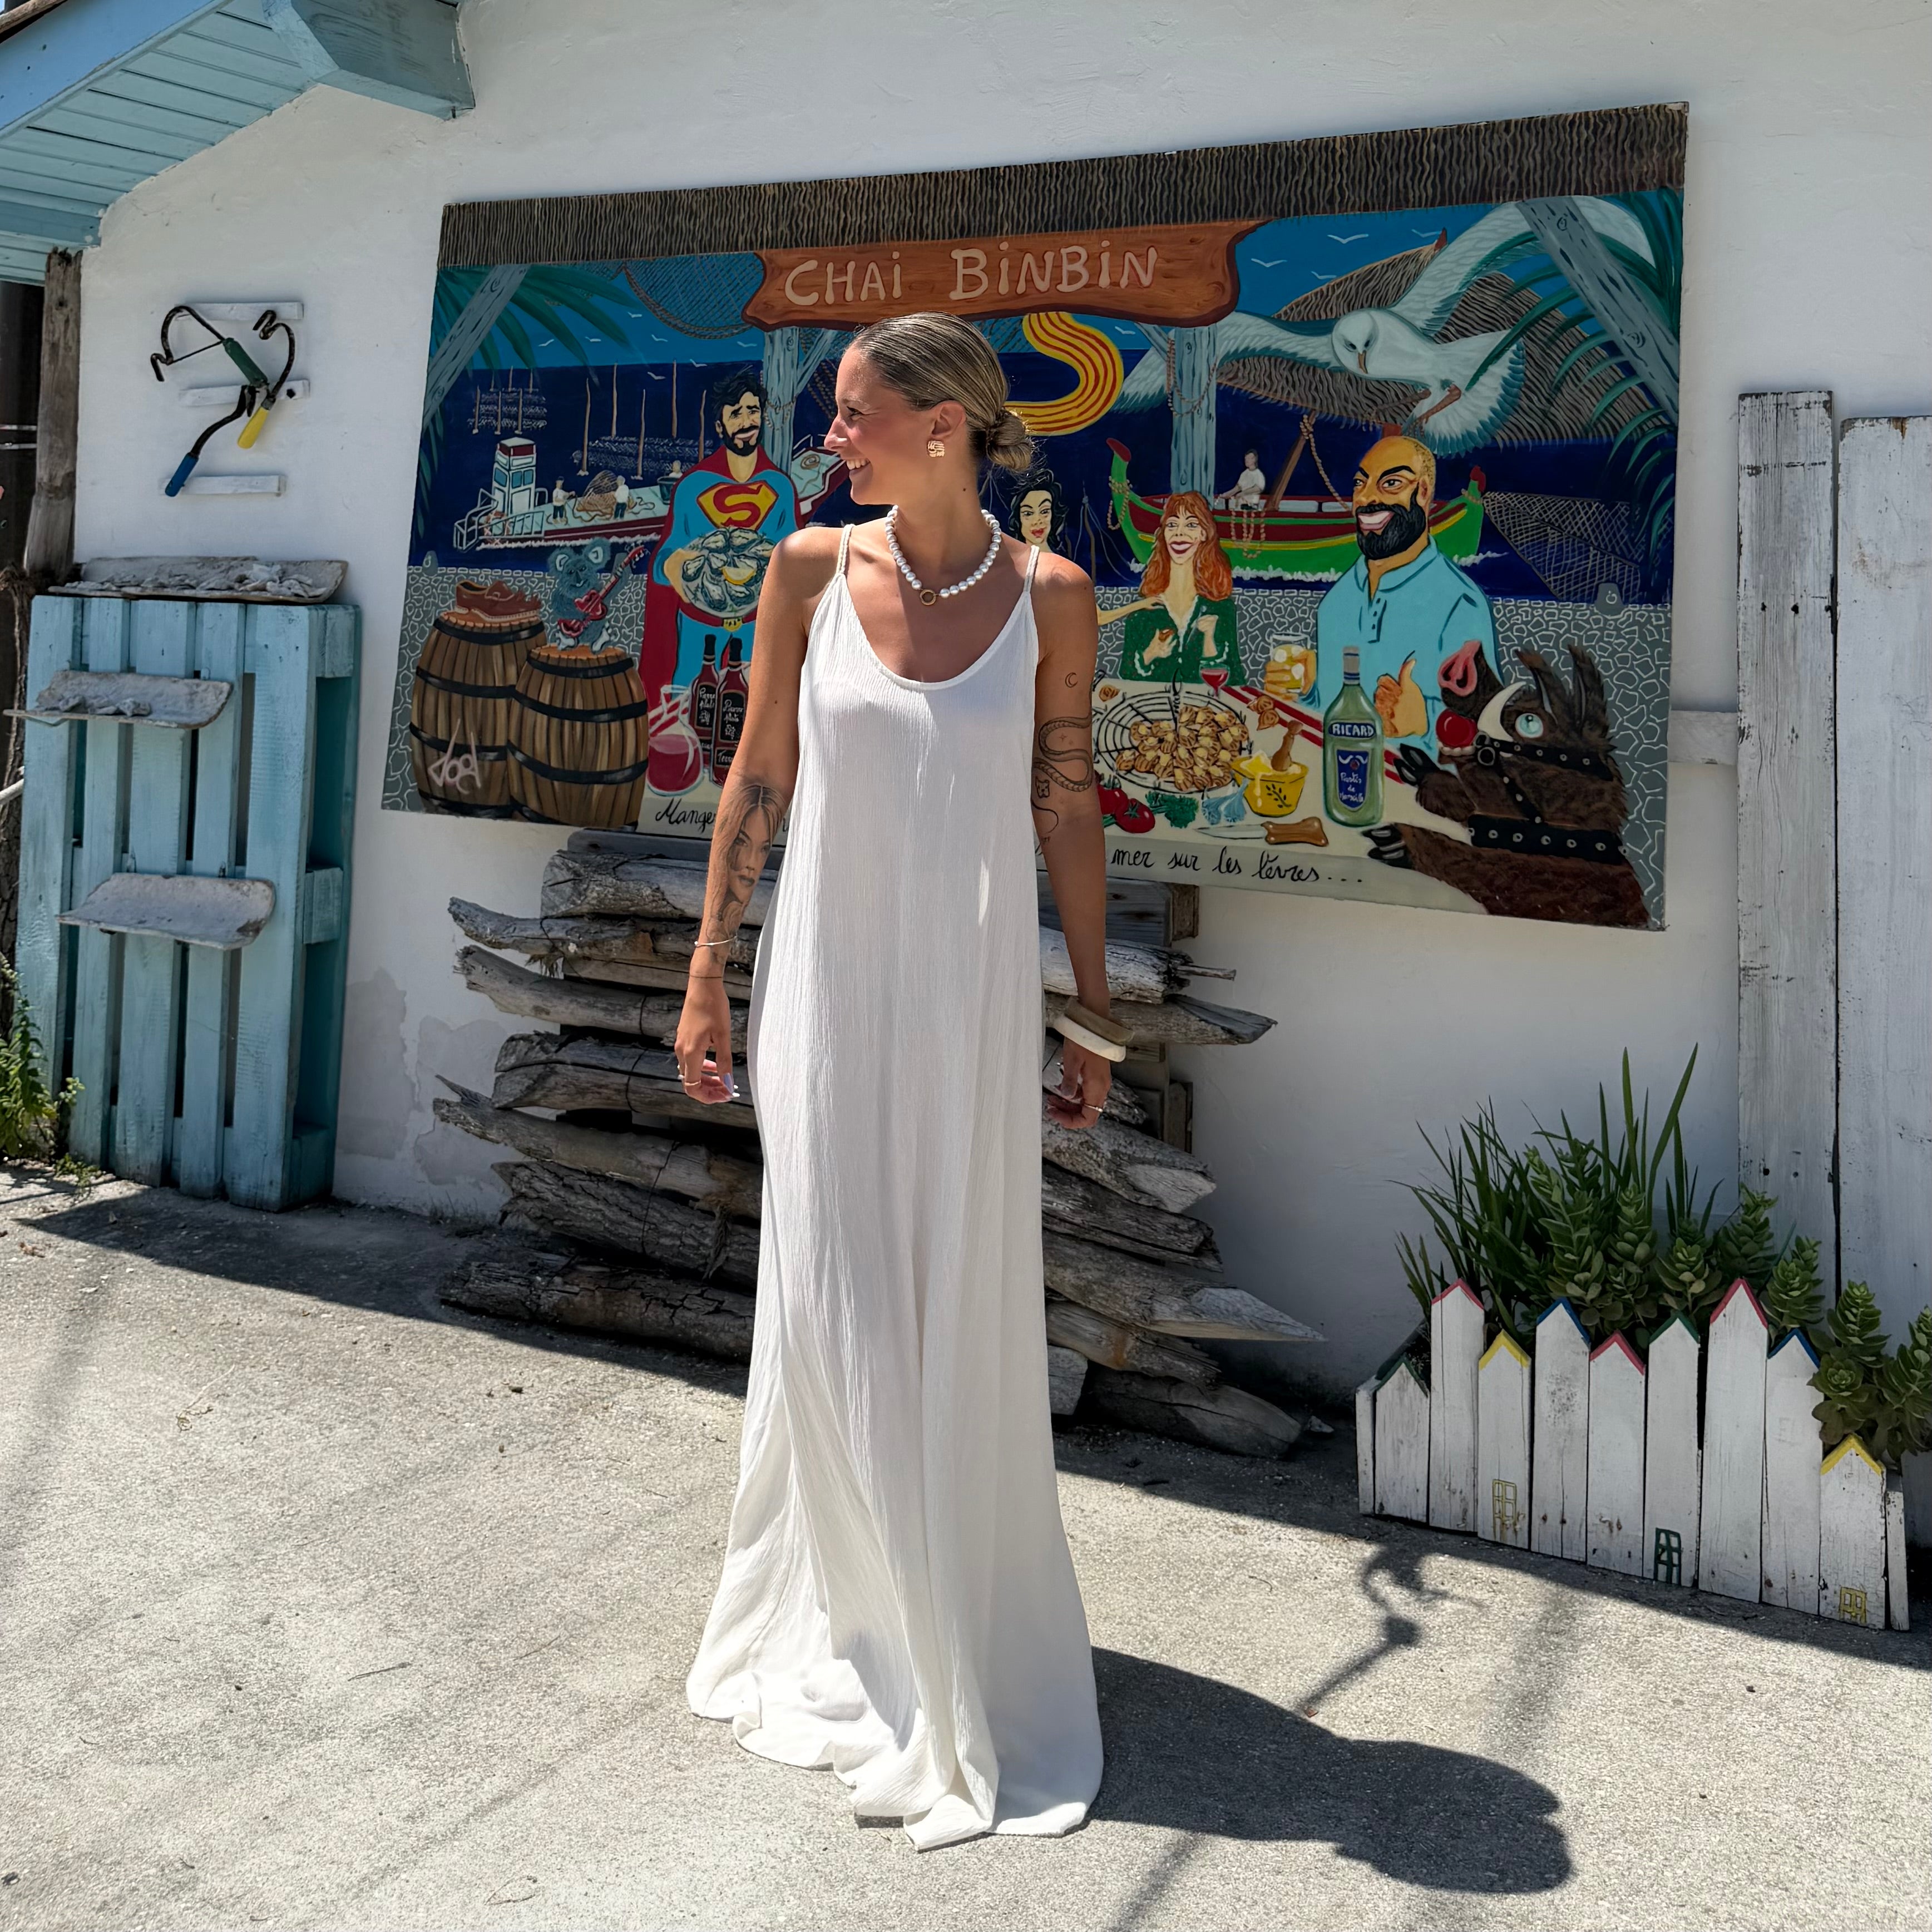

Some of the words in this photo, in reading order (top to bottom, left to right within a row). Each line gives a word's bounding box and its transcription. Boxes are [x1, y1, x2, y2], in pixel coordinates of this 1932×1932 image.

[1332, 724, 1374, 737] RICARD
[655, 798, 716, 833] Mange
[1111, 848, 1155, 868] mer
[1167, 852, 1201, 872] sur
[1212, 845, 1242, 875] les
